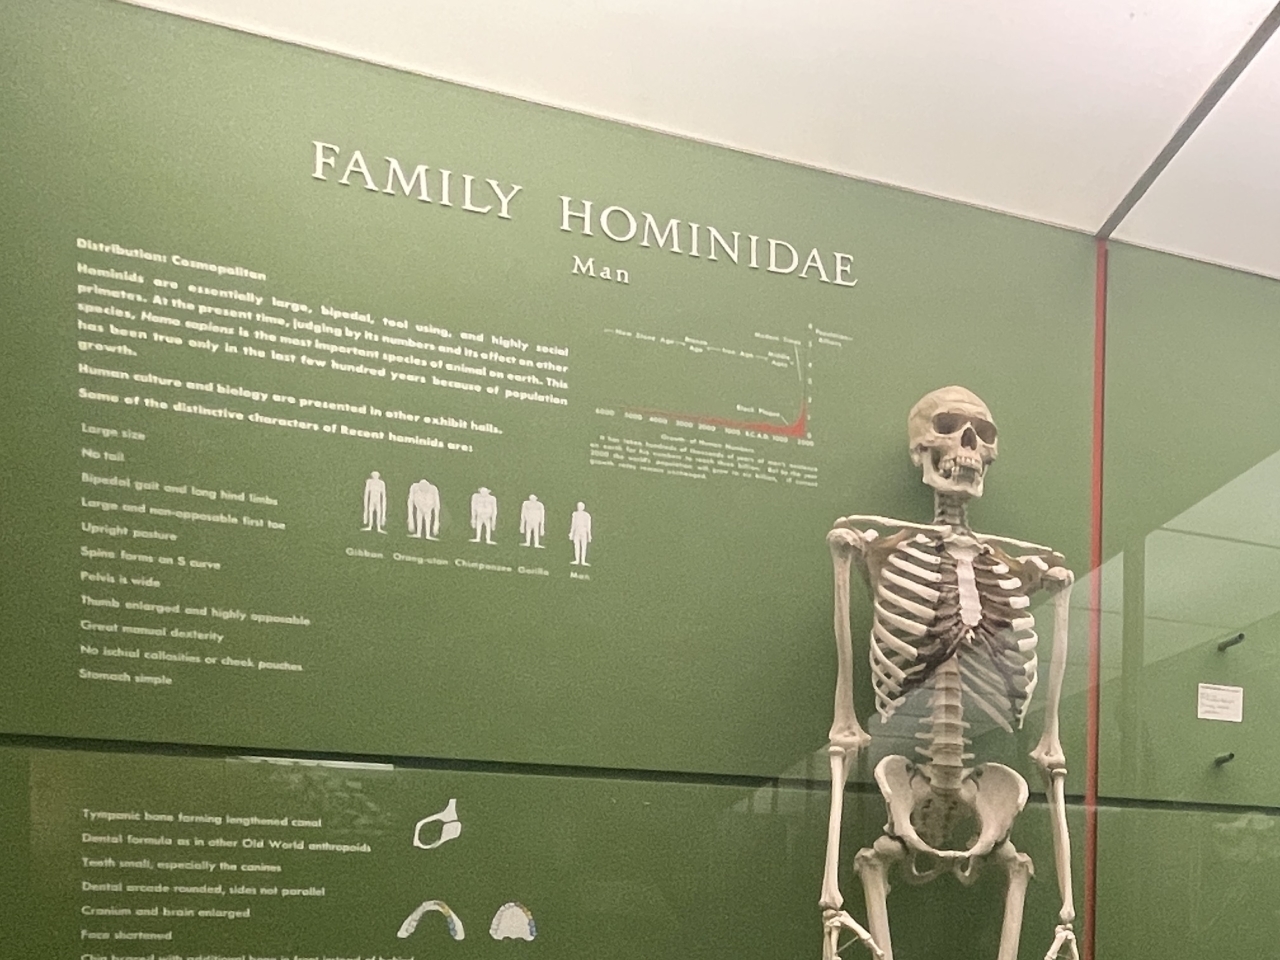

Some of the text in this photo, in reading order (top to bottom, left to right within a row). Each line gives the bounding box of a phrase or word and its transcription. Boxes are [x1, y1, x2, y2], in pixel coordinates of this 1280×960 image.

[312, 141, 857, 286] FAMILY HOMINIDAE
[77, 238, 266, 280] Distribution: Cosmopolitan
[572, 255, 628, 283] Man
[77, 263, 568, 356] Hominids are essentially large, bipedal, tool using, and highly social
[78, 284, 147, 302] primates.
[153, 295, 168, 305] At
[172, 299, 195, 310] the
[199, 305, 252, 319] present
[256, 313, 289, 327] time,
[293, 319, 342, 337] judging
[345, 327, 361, 340] by
[365, 331, 379, 341] its
[382, 336, 435, 350] numbers
[438, 346, 461, 355] and
[465, 348, 478, 358] its
[481, 352, 516, 363] effect
[536, 362, 568, 372] other
[78, 303, 135, 320] species,
[141, 311, 180, 326] Homo
[185, 321, 234, 334] sapiens
[239, 327, 249, 337] is
[254, 331, 276, 341] the
[280, 336, 312, 347] most
[315, 339, 379, 358] important
[383, 353, 427, 366] species
[430, 360, 443, 368] of
[446, 364, 486, 376] animal
[507, 374, 543, 384] earth.
[546, 377, 568, 388] This
[79, 388, 472, 452] Some of the distinctive characters of Recent hominids are:
[82, 423, 145, 440] Large size
[81, 448, 124, 461] No tail
[82, 472, 278, 505] Bipedal gait and long hind limbs
[81, 522, 177, 540] Upright posture
[81, 546, 115, 558] Spine
[121, 550, 153, 562] forms
[178, 557, 186, 566] S
[190, 560, 221, 569] curve
[80, 571, 160, 587] Pelvis is wide
[80, 620, 224, 643] Great manual dexterity
[79, 668, 172, 685] Stomach simple
[83, 809, 321, 827] Tympanic bone forming lengthened canal
[82, 833, 122, 843] Dental
[127, 835, 172, 845] formula
[195, 837, 204, 845] in
[208, 838, 237, 847] other
[242, 838, 264, 848] Old
[269, 840, 304, 849] World
[309, 842, 371, 853] anthropoids
